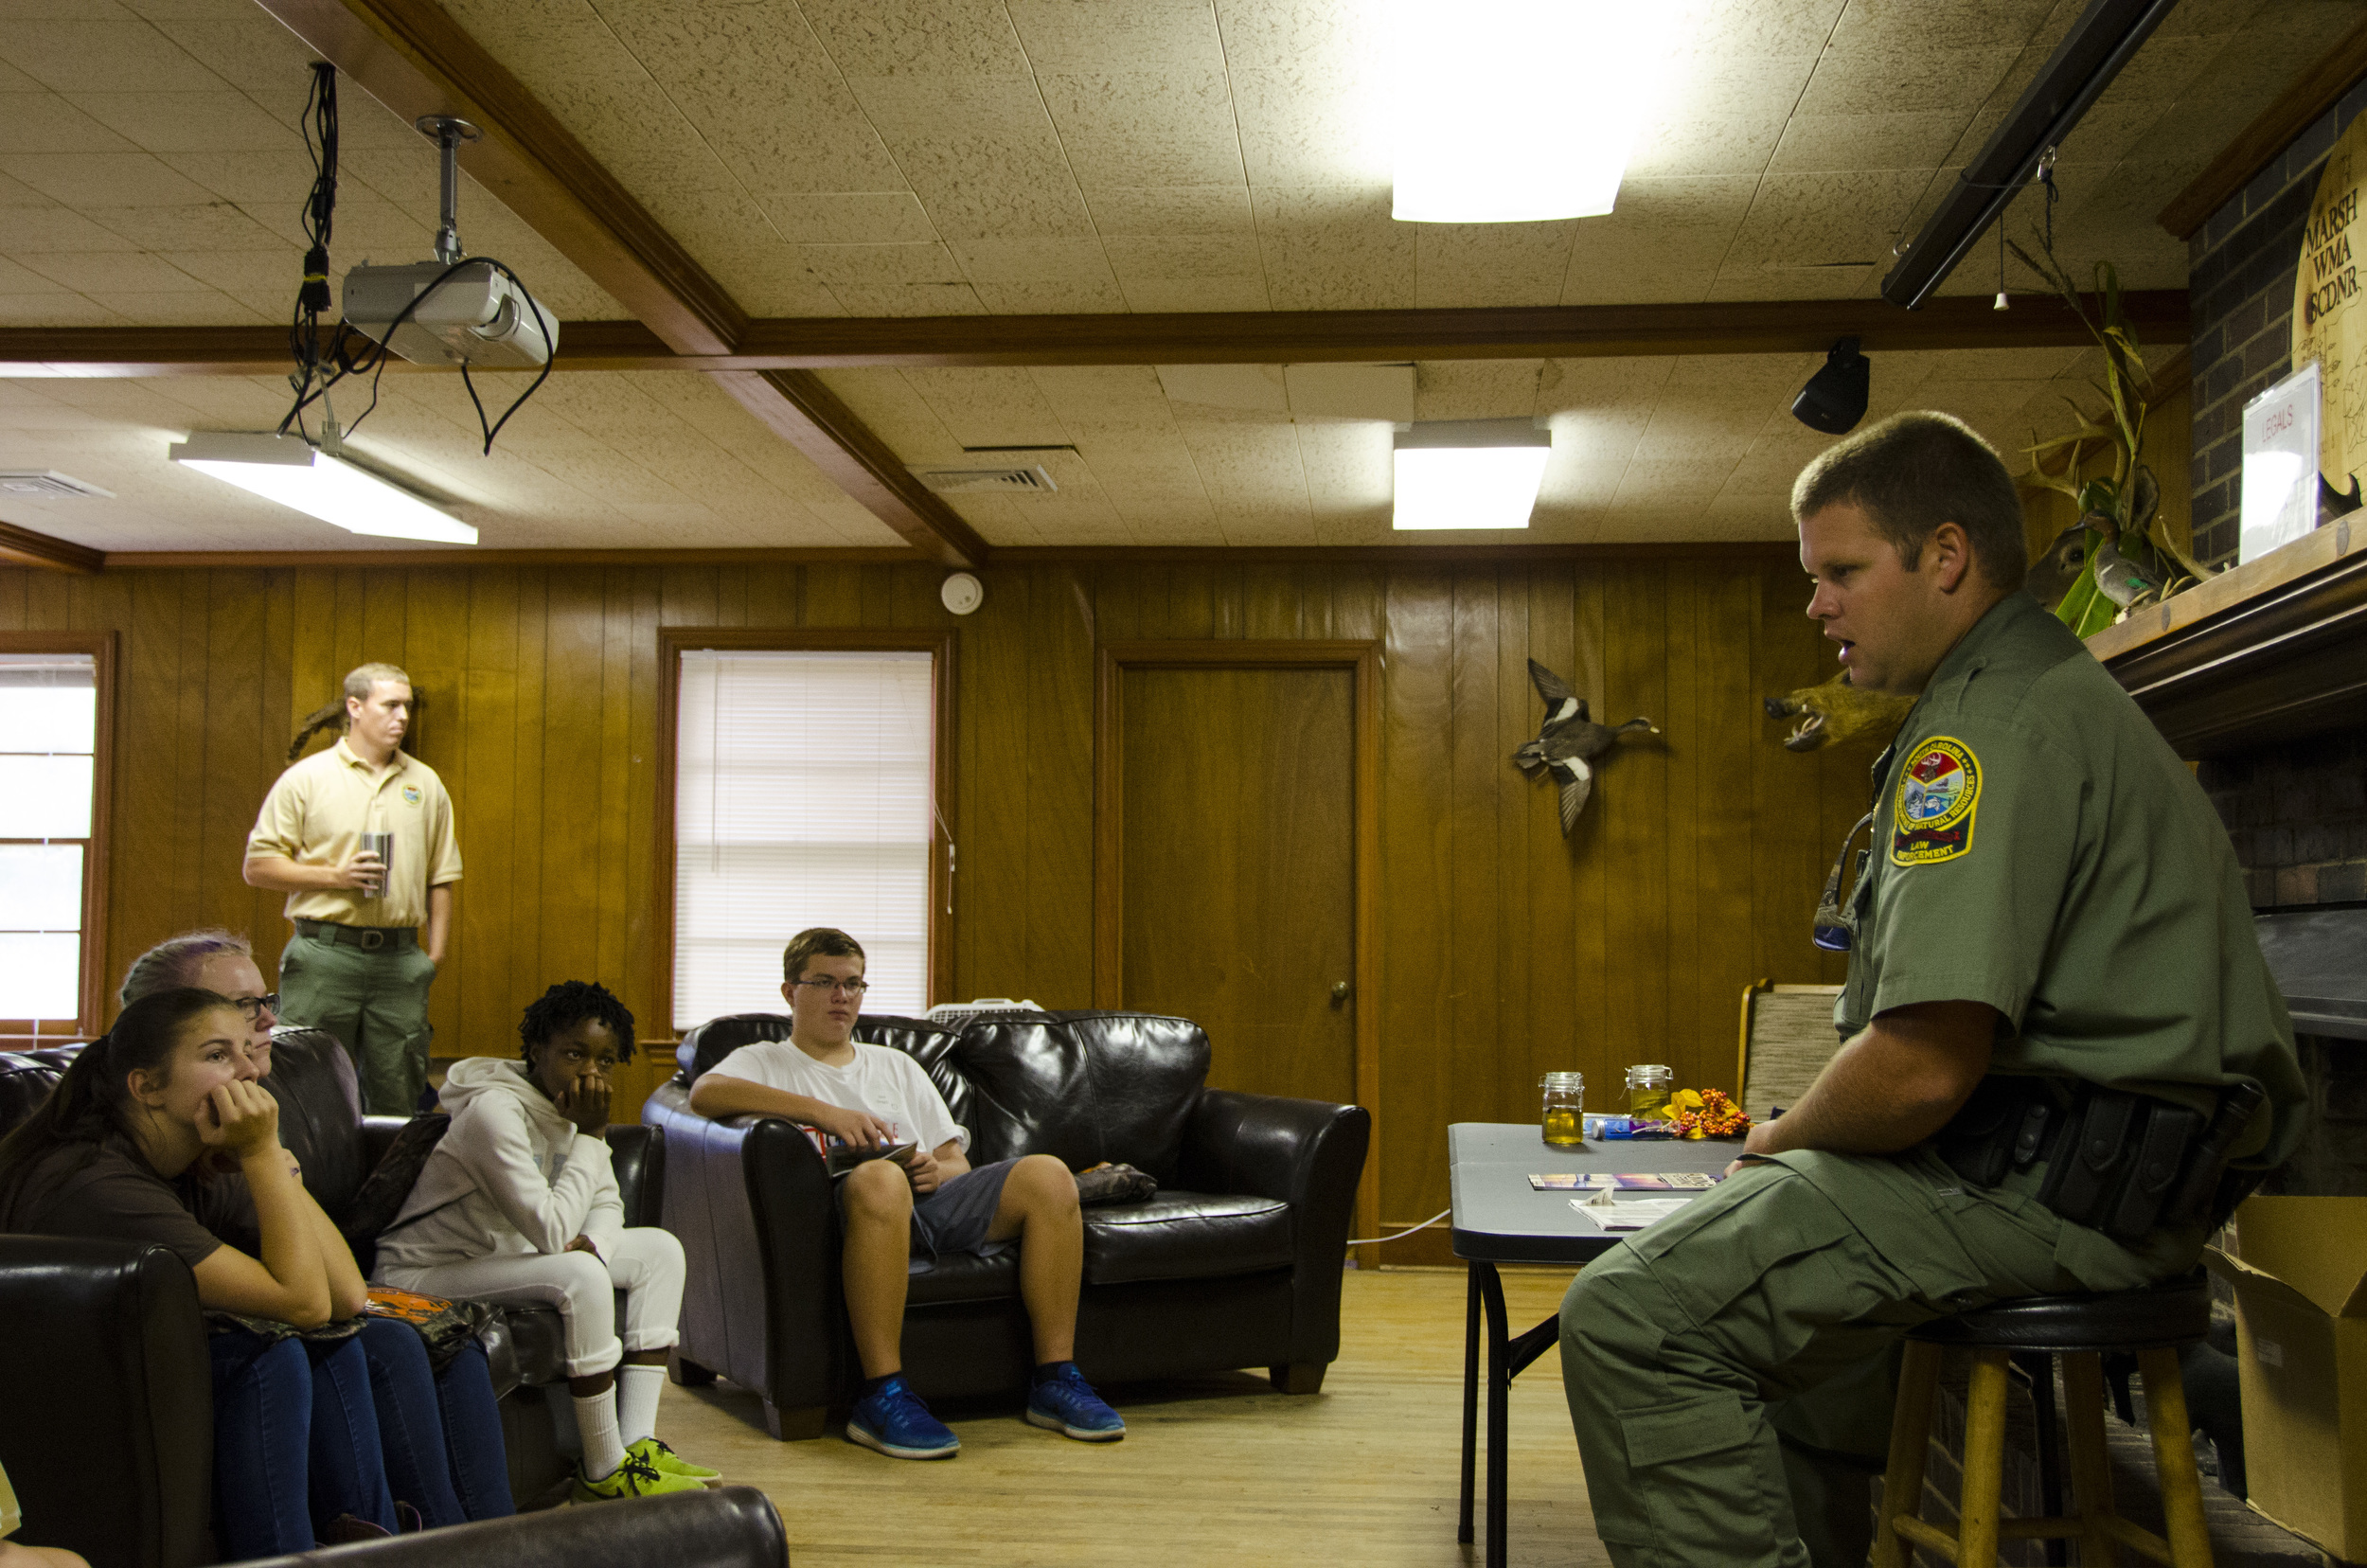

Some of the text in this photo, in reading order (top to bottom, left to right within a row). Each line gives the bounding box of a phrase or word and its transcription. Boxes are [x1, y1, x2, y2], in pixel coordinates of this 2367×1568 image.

[2305, 187, 2358, 259] MARSH
[2312, 233, 2353, 283] WMA
[2309, 265, 2358, 325] SCDNR
[2261, 404, 2294, 443] LEGALS
[1929, 741, 1965, 759] CAROLINA
[1914, 816, 1951, 830] NATURAL
[1949, 775, 1975, 818] RESOURCES
[1910, 841, 1930, 851] LAW
